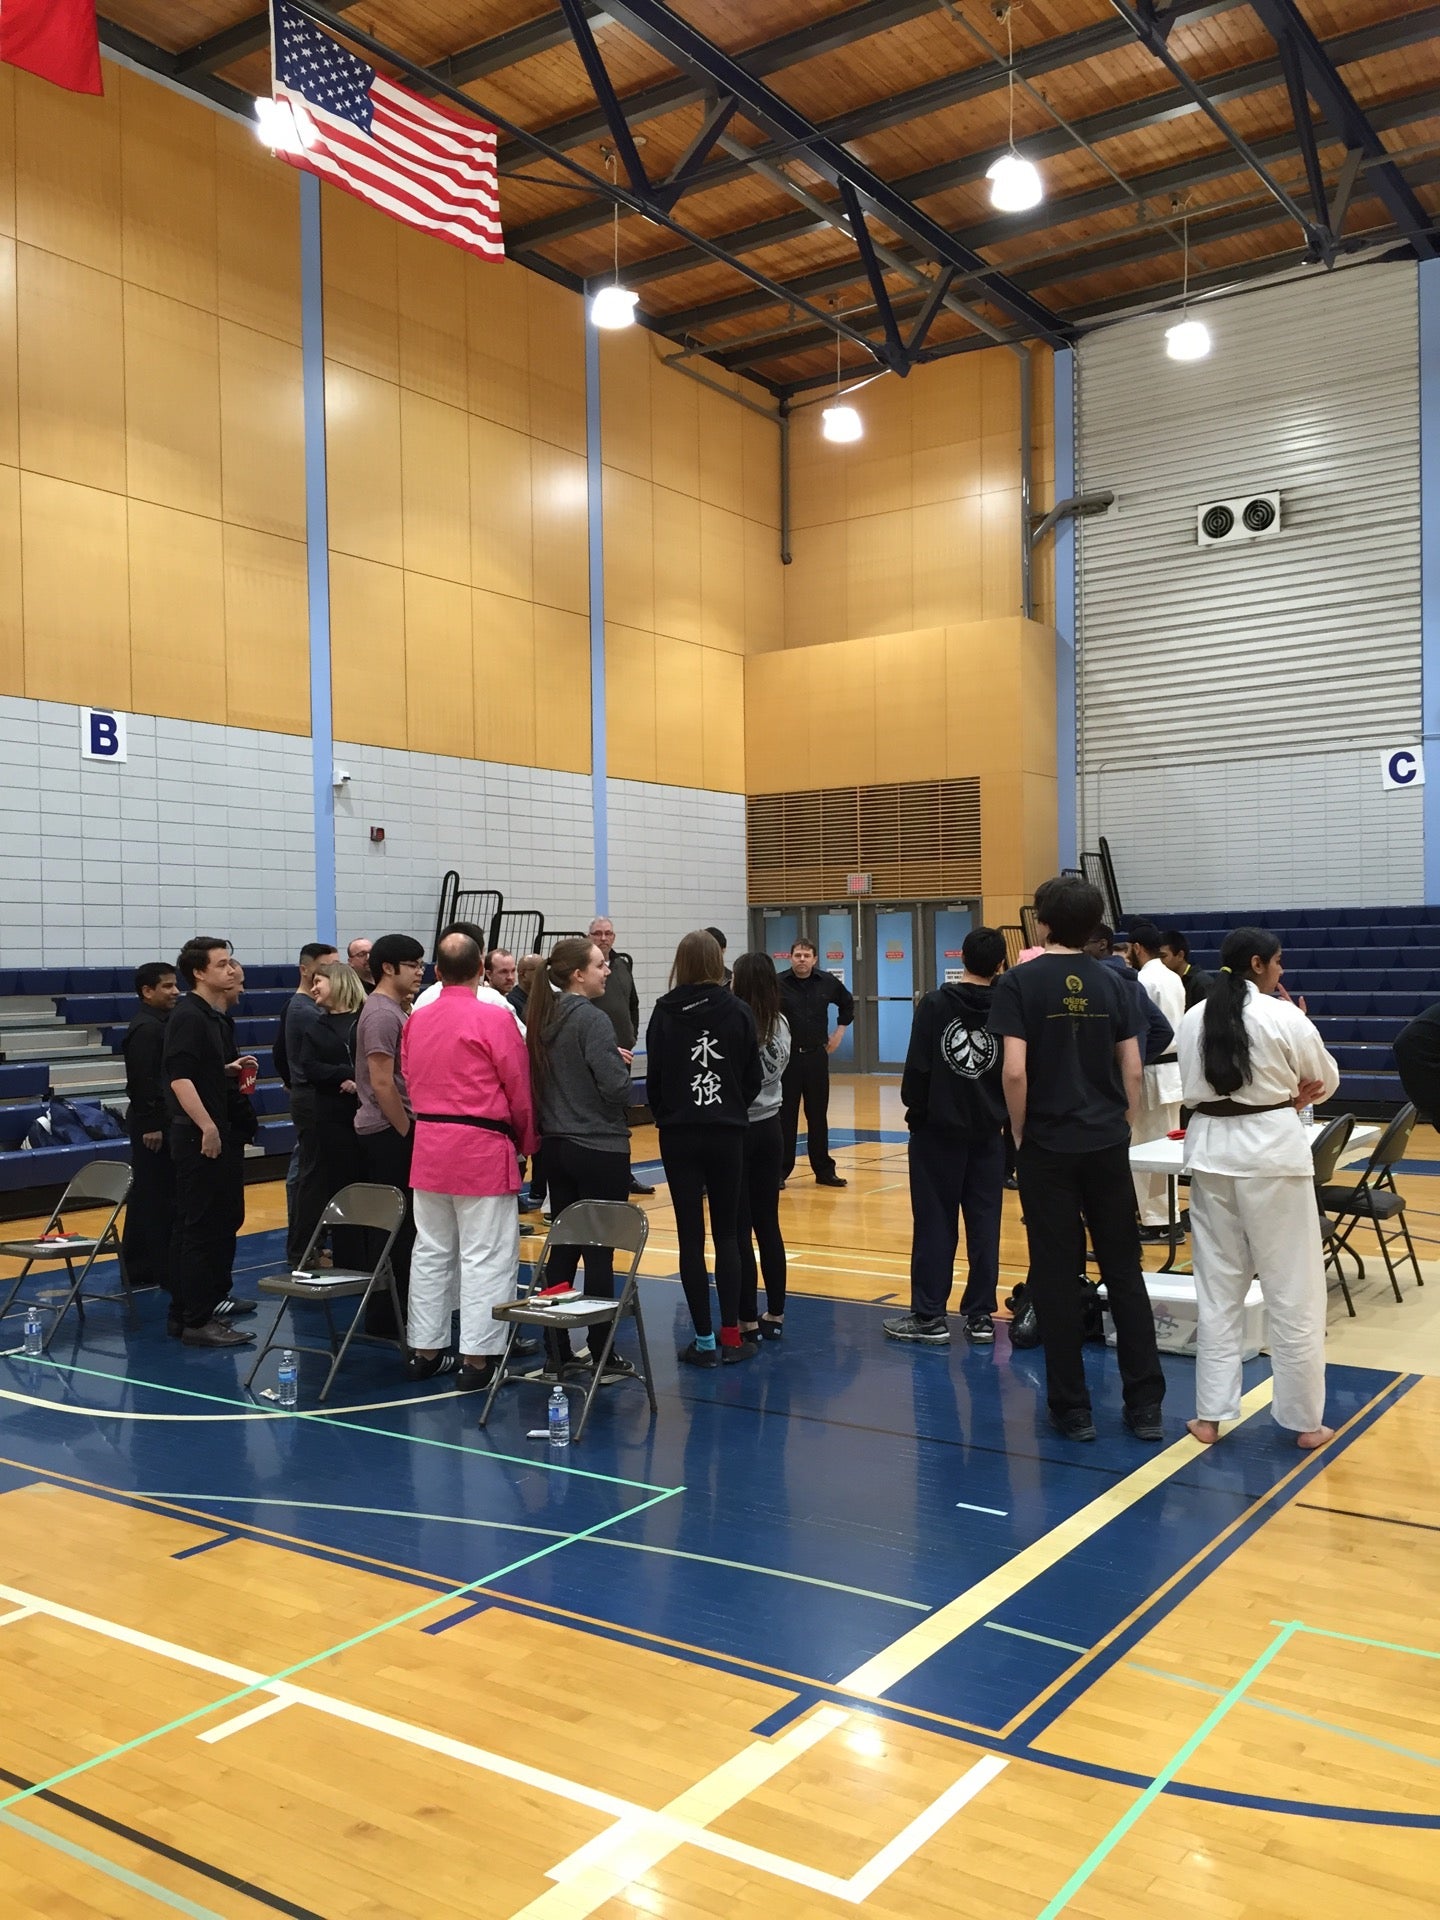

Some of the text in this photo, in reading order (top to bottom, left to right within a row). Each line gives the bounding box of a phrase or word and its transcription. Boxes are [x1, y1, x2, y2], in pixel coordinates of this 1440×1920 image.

[90, 713, 119, 756] B
[1388, 751, 1417, 784] C
[690, 1029, 726, 1107] 永強
